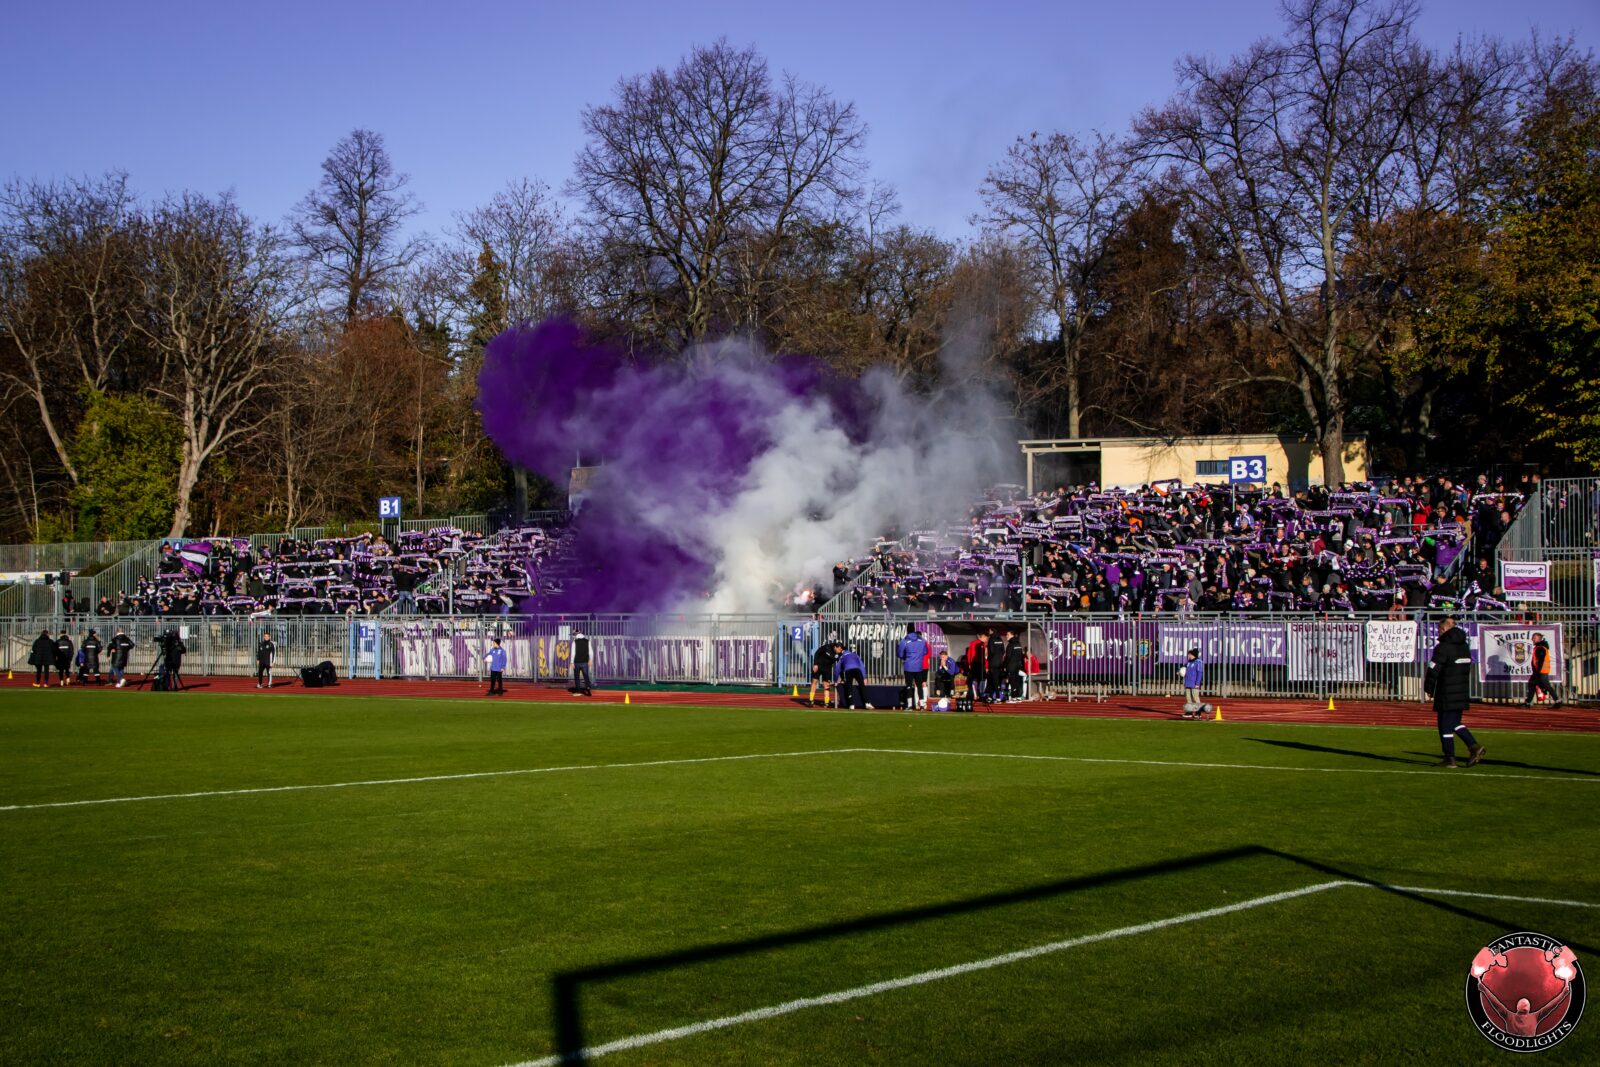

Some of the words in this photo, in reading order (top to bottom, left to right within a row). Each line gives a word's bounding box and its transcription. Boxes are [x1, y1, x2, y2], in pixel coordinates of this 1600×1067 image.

[1231, 459, 1264, 479] B3
[380, 499, 399, 515] B1
[794, 627, 801, 640] 2
[1382, 624, 1413, 635] Wilden
[1494, 631, 1530, 646] Fancl
[1504, 664, 1532, 675] Mekk
